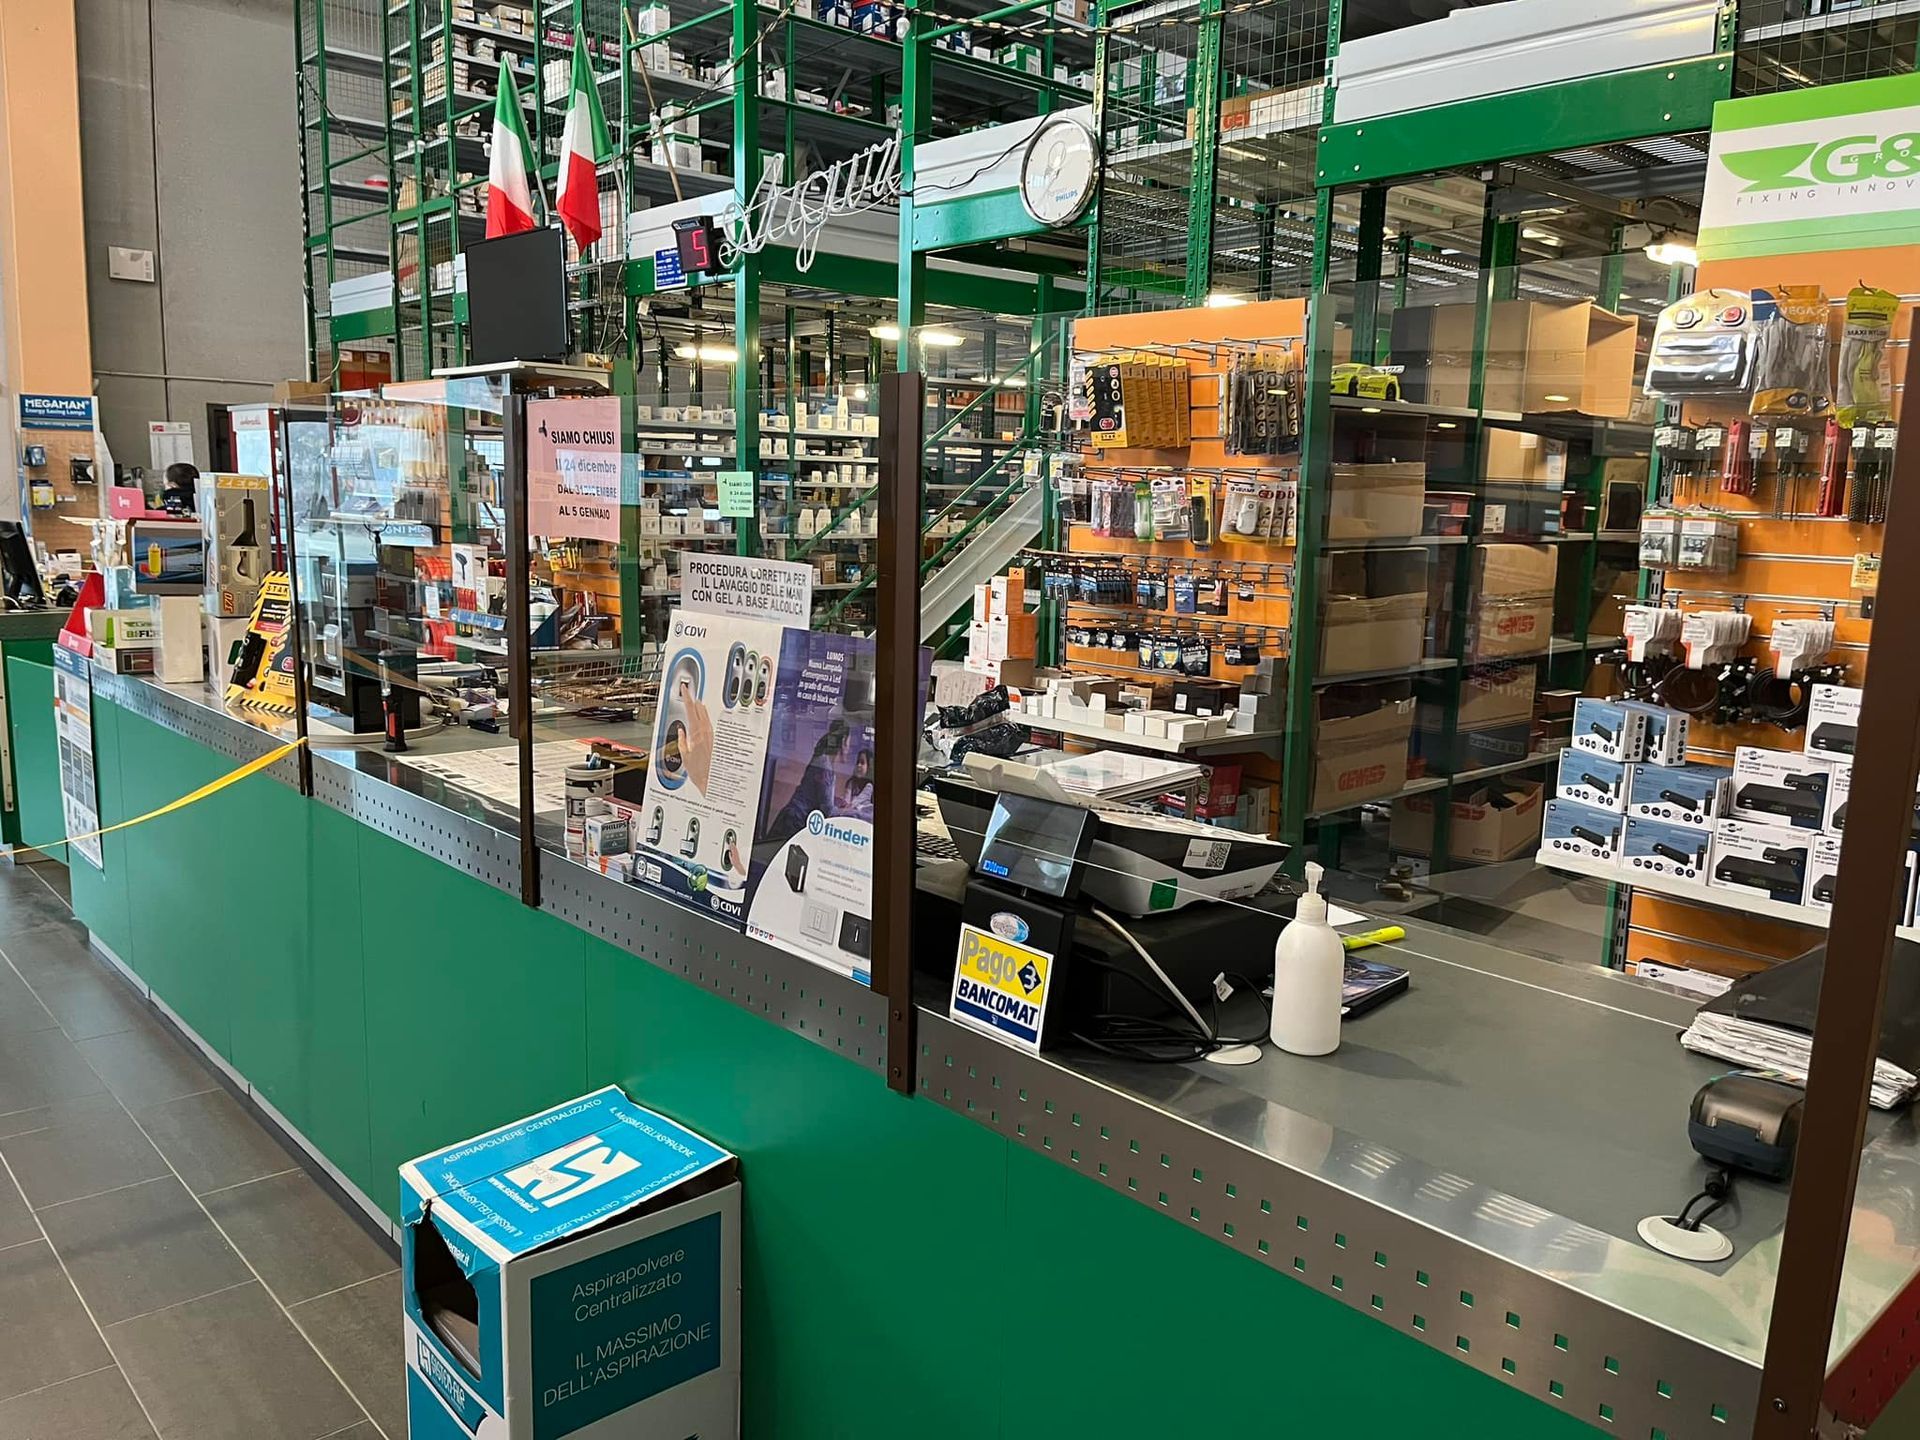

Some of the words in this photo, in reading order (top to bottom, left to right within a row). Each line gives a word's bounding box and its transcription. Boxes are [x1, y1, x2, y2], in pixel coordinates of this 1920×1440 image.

[1056, 189, 1078, 202] PHILIPS
[1736, 189, 1816, 206] FIXING
[1837, 179, 1914, 196] INNOV
[692, 229, 708, 267] 5
[1780, 306, 1817, 316] VEGA
[25, 407, 46, 416] Energy
[551, 430, 581, 445] SIAMO
[583, 430, 615, 446] CHIUSI
[564, 459, 576, 472] 24
[578, 459, 617, 474] dicembre
[216, 477, 268, 489] ZECA
[557, 483, 574, 495] DAL
[559, 505, 571, 516] AL
[572, 506, 578, 517] 5
[579, 506, 611, 520] GENNAIO
[690, 562, 748, 579] PROCEDURA
[750, 568, 792, 584] CORRETTA
[793, 572, 807, 587] PER
[701, 576, 710, 589] IL
[713, 578, 758, 594] LAVAGGIO
[760, 582, 785, 598] DELLE
[786, 586, 803, 601] MANI
[692, 589, 712, 602] CON
[715, 592, 734, 606] GEL
[736, 595, 743, 606] A
[746, 596, 768, 609] BASE
[770, 599, 803, 616] ALCOLICA
[684, 624, 707, 638] CDVI
[808, 659, 822, 670] Nuova
[822, 661, 843, 673] Lampada
[826, 651, 845, 662] LUMOS
[817, 693, 829, 704] black
[822, 684, 840, 695] attivarsi
[1338, 764, 1386, 792] GEWISS
[602, 822, 627, 831] PHILIPS
[824, 822, 869, 847] finder
[983, 859, 1009, 877] Ditron
[720, 901, 741, 917] CDVI
[962, 931, 1016, 985] Pago
[958, 978, 1039, 1027] BANCOMAT
[442, 1128, 527, 1165] ASPIRAPOLVERE
[525, 1098, 602, 1133] CENTRALIZZATO
[622, 1160, 700, 1201] ASPIRAPOLVERE
[532, 1200, 620, 1242] CENTRALIZZATO
[571, 1249, 685, 1302] Aspirapolvere
[574, 1271, 682, 1322] Centralizzato
[576, 1352, 592, 1370] IL
[596, 1313, 682, 1361] MASSIMO
[543, 1322, 712, 1408] DELL'ASPIRAZIONE
